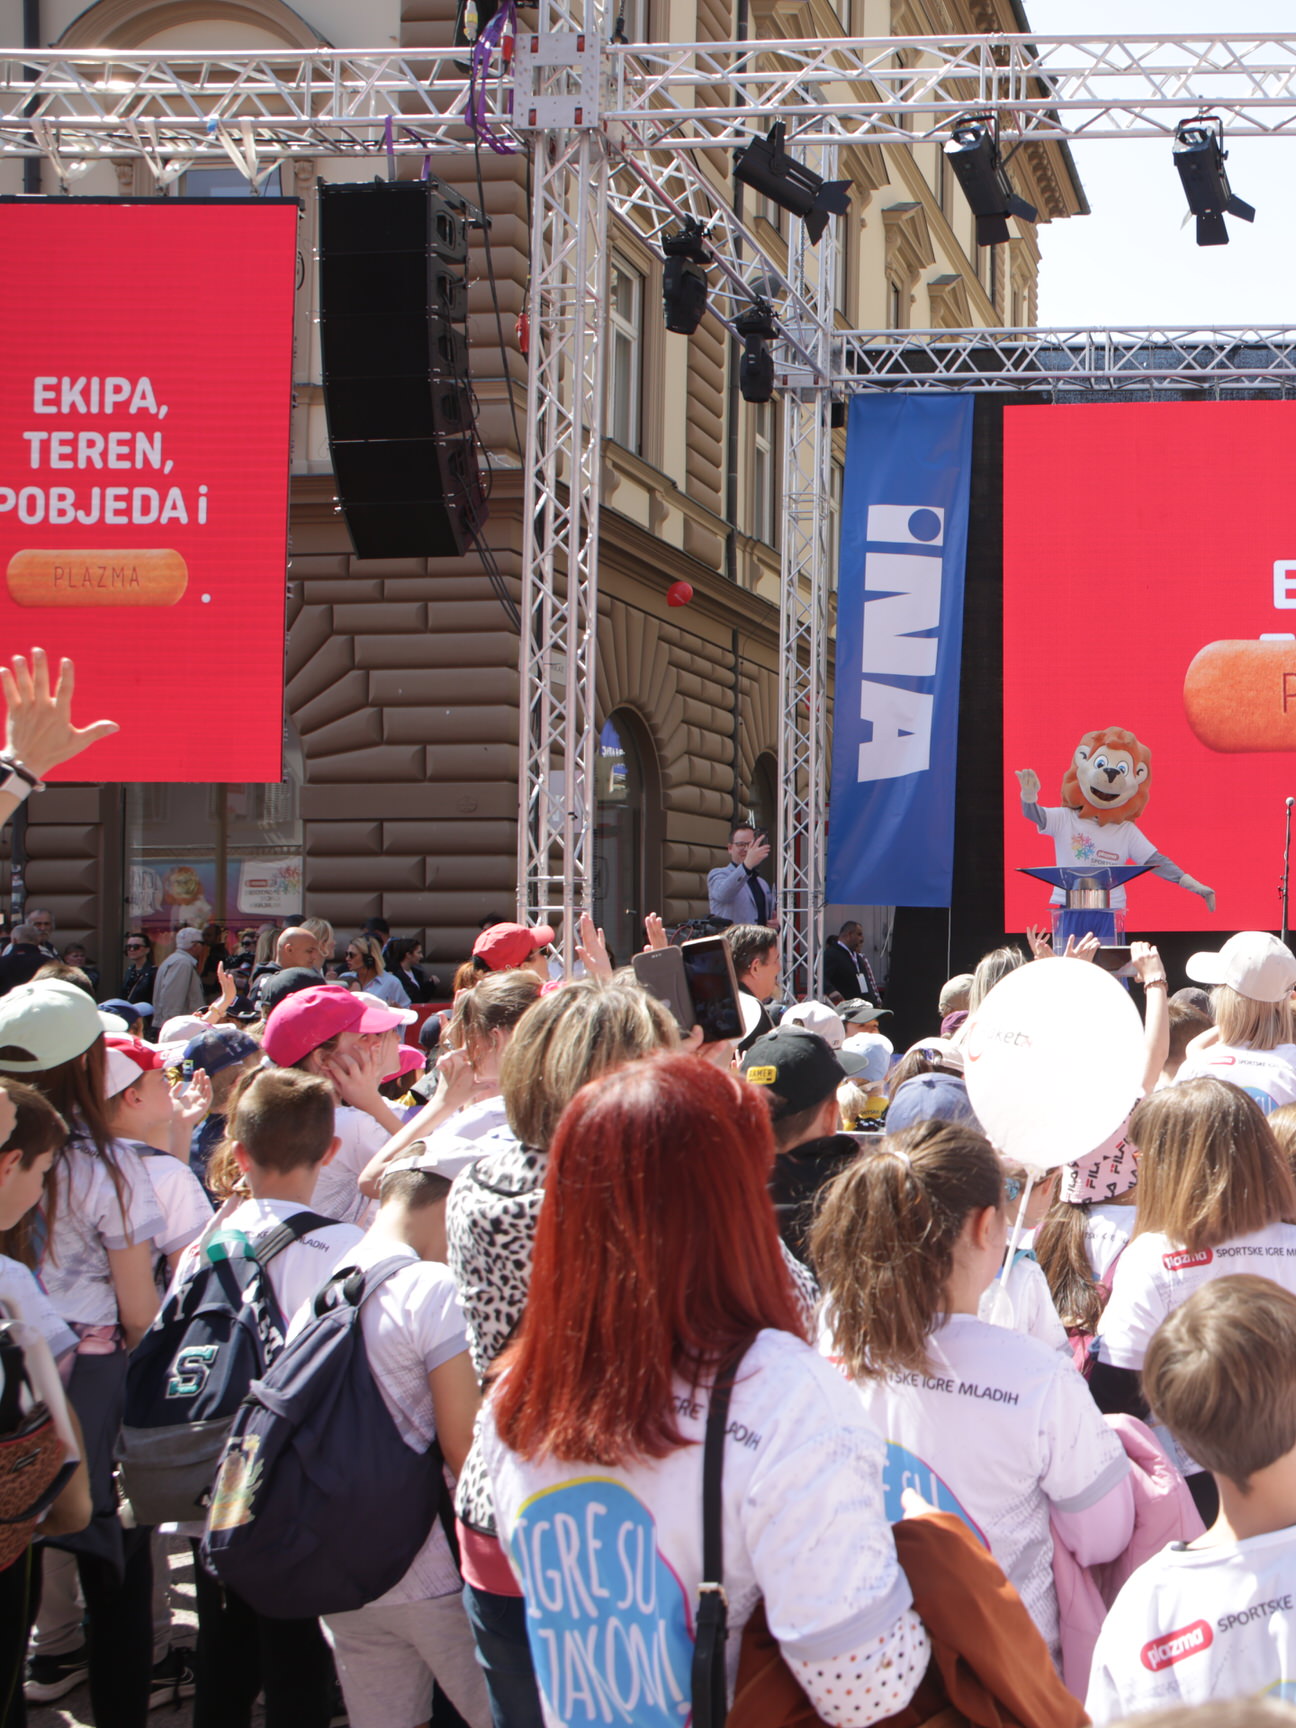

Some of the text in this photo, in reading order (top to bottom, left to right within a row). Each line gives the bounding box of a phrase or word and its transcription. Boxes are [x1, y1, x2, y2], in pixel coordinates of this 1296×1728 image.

[33, 376, 169, 420] EKIPA,
[22, 431, 174, 475] TEREN,
[198, 484, 208, 525] i
[53, 566, 141, 588] PLAZMA
[1216, 1246, 1263, 1258] SPORTSKE
[1265, 1247, 1284, 1257] IGRE
[165, 1344, 219, 1399] S
[921, 1375, 955, 1394] IGRE
[957, 1381, 1020, 1406] MLADIH
[513, 1502, 658, 1620] IGRE SU
[1146, 1627, 1205, 1669] plazma
[1217, 1594, 1293, 1633] SPORTSKE
